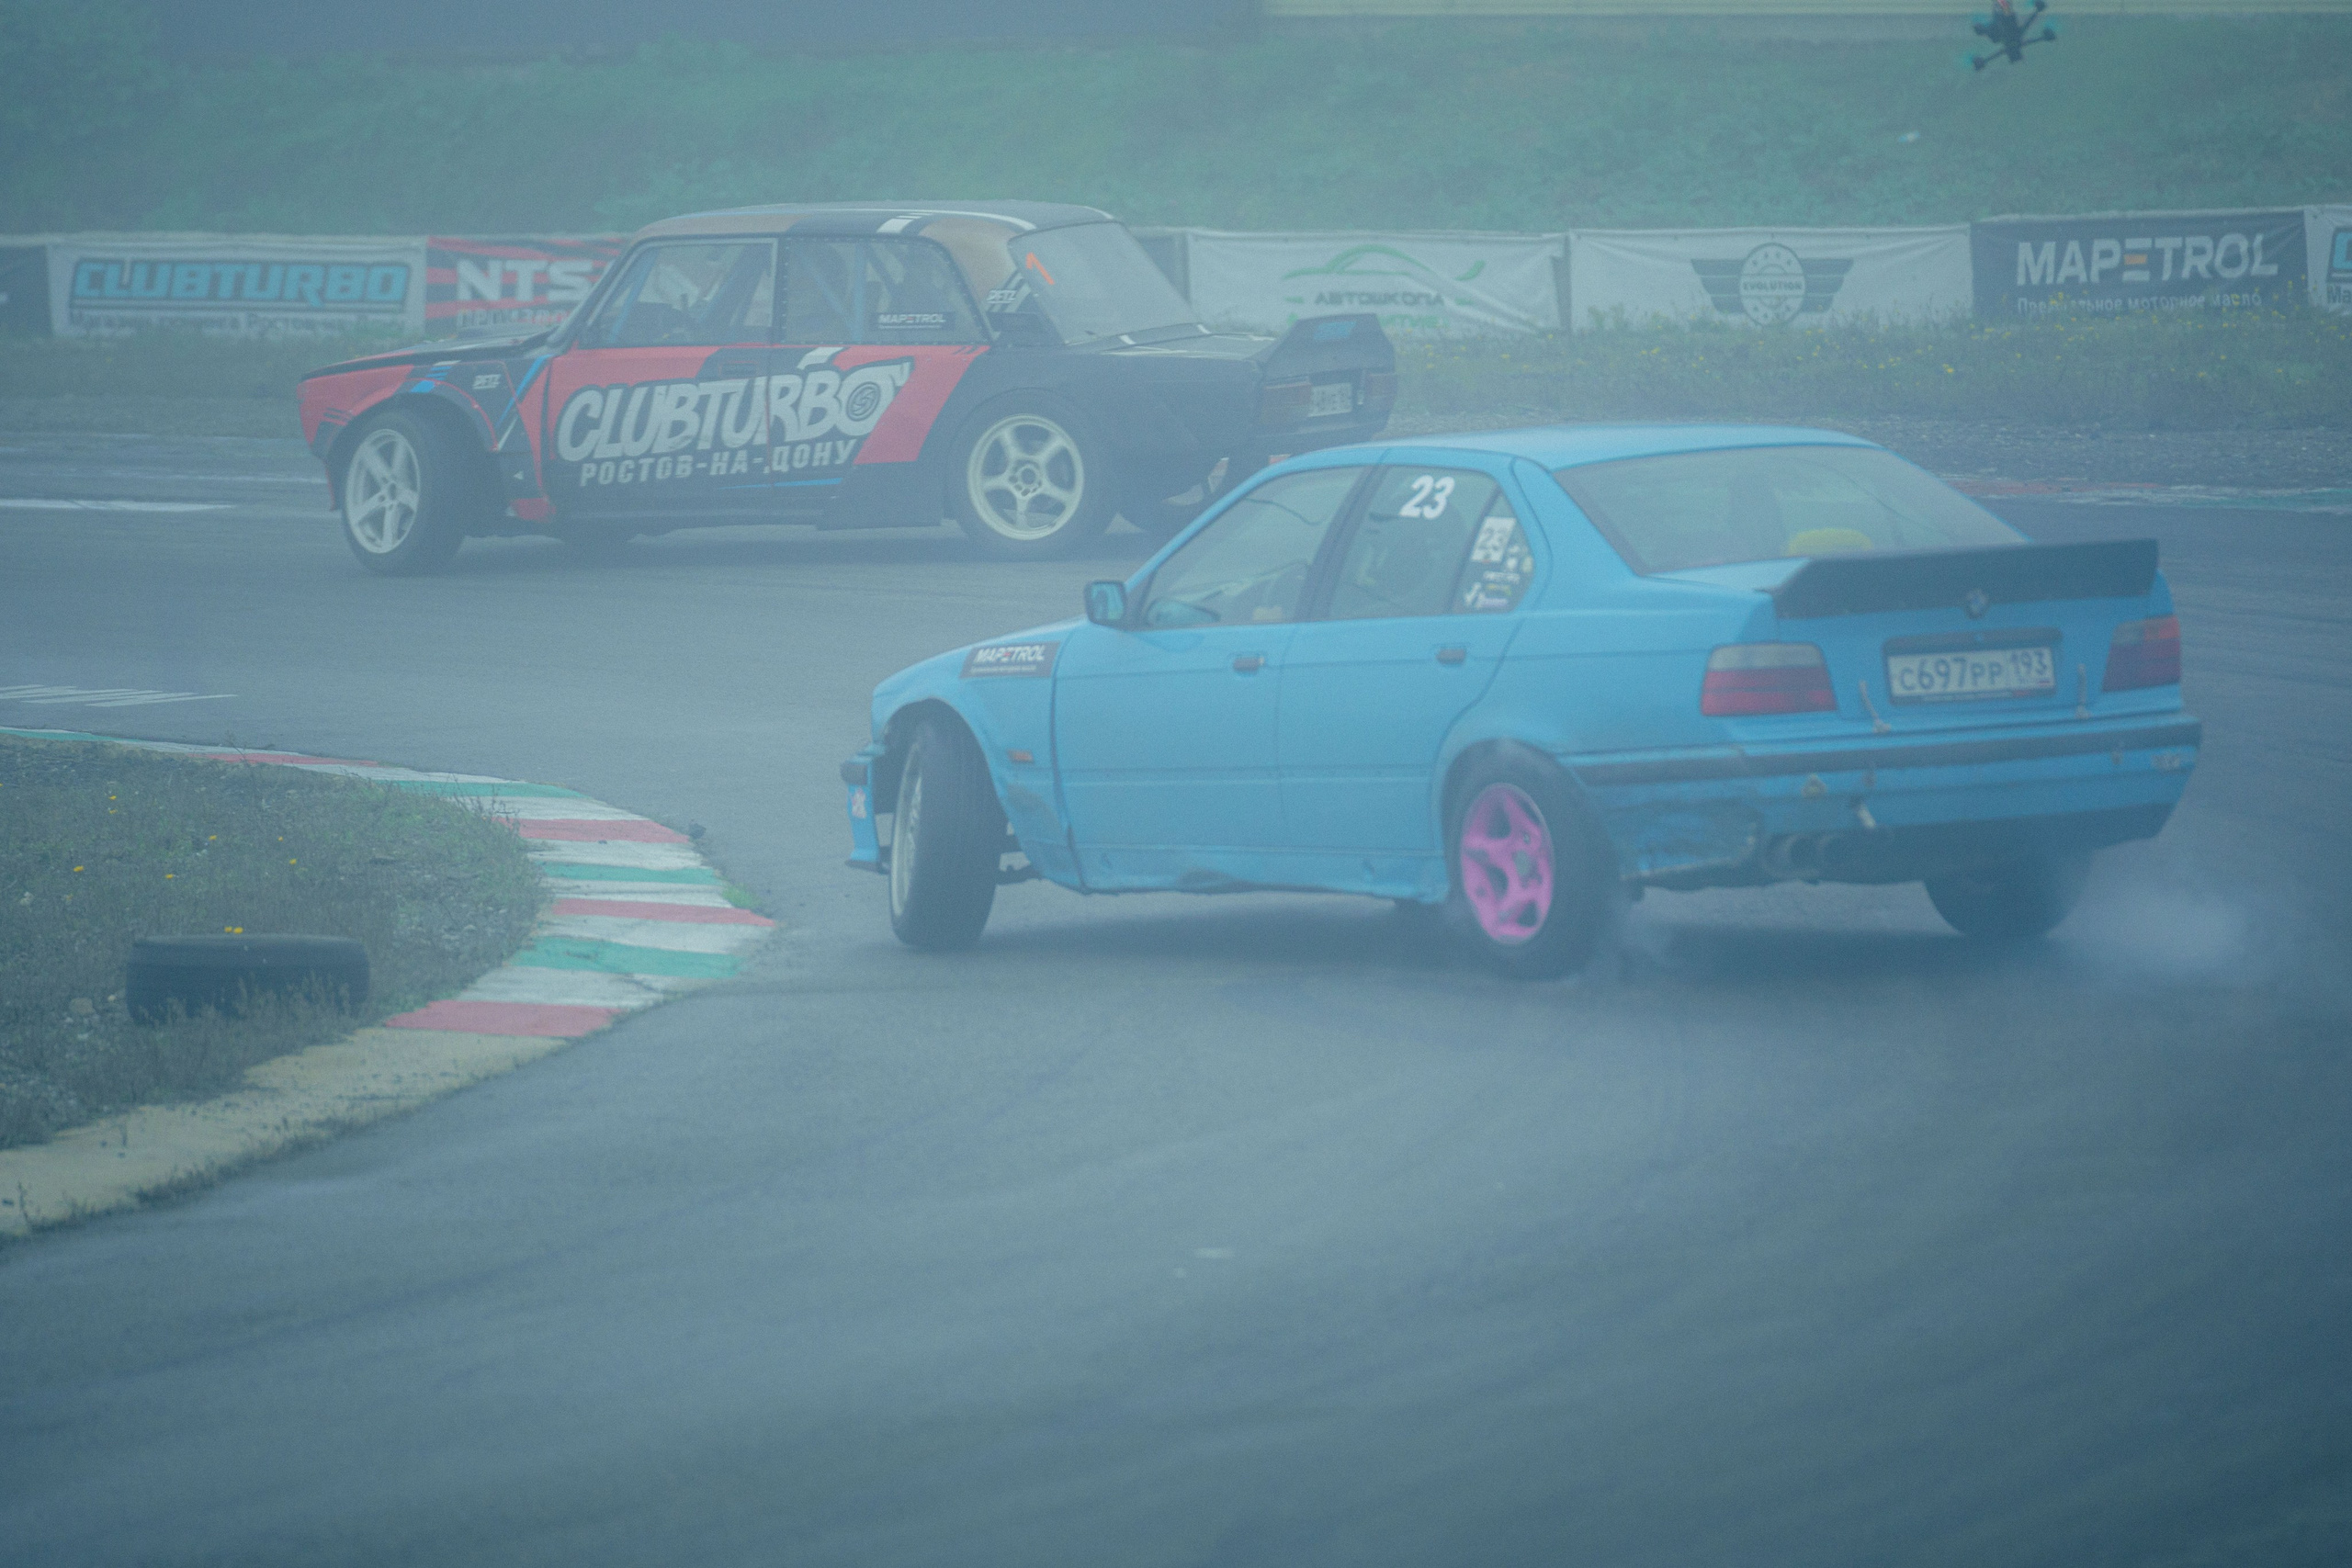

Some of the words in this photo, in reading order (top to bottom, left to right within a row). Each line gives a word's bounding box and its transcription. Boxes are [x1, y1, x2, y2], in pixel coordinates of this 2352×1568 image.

[2016, 233, 2278, 286] MAPETROL
[74, 261, 410, 307] CLUBTURBO
[878, 313, 946, 323] MAPETROL
[558, 361, 912, 462] CLUBTURBO
[580, 439, 857, 488] РОСТОВ-НА-ДОНУ
[1399, 474, 1455, 520] 23
[973, 645, 1046, 663] MAPETROL
